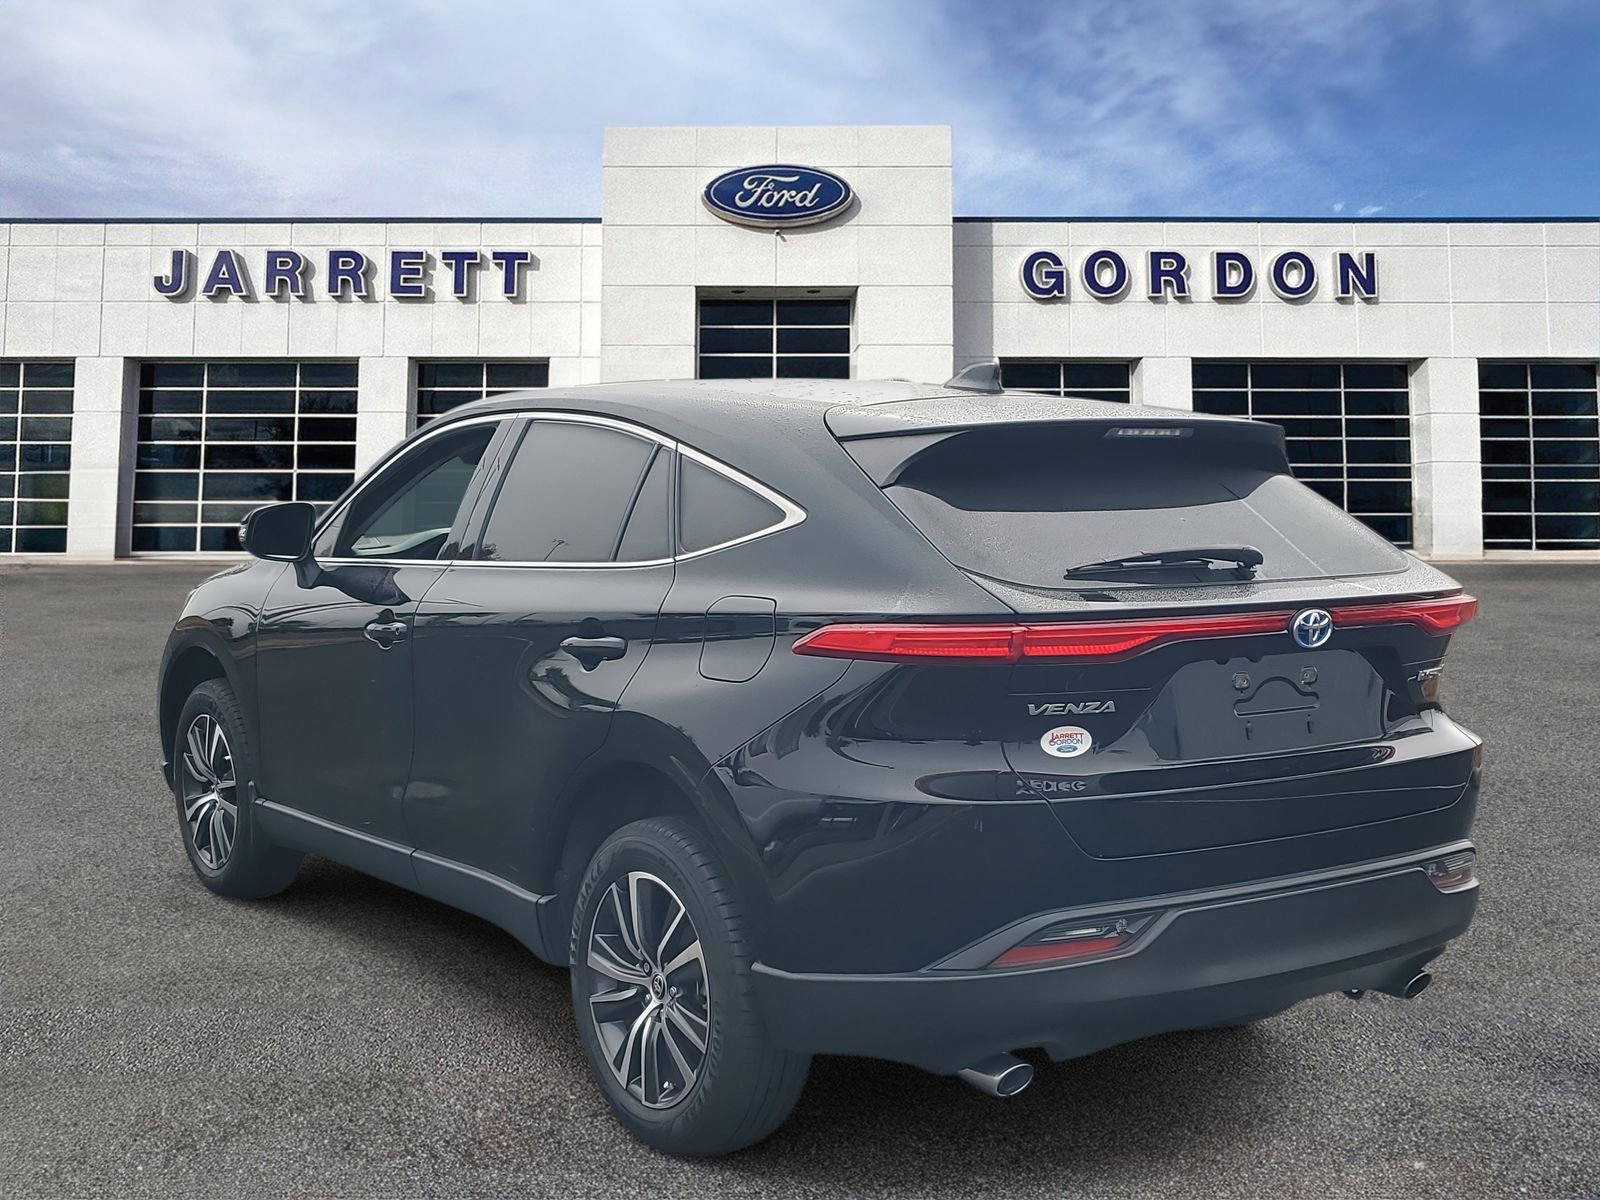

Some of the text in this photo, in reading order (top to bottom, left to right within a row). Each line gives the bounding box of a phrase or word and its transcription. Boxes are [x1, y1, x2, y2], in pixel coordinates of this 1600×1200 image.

[734, 174, 822, 208] Ford
[153, 248, 531, 298] JARRETT
[1019, 249, 1380, 301] GORDON
[1027, 700, 1116, 716] VENZA
[1048, 738, 1083, 746] GORDON
[1051, 732, 1084, 741] JARRETT
